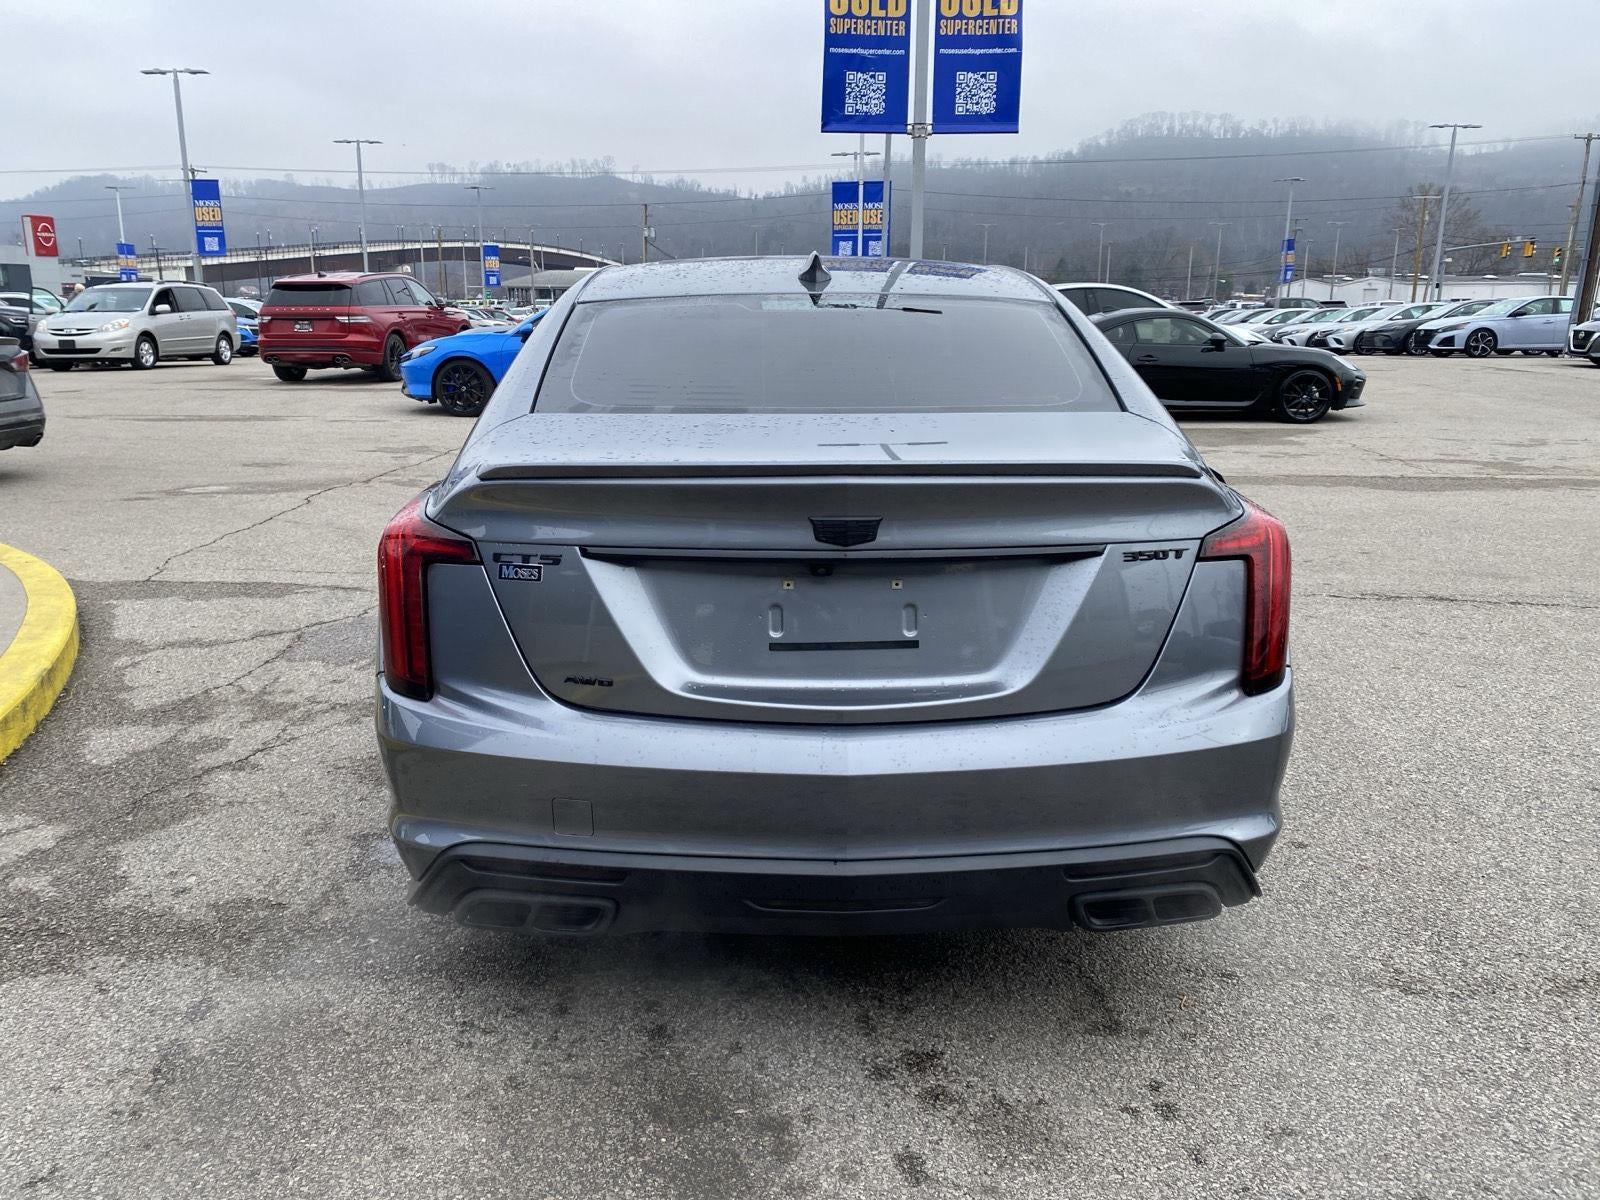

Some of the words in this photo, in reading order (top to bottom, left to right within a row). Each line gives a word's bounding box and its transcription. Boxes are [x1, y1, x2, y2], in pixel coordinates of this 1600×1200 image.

[829, 17, 906, 36] SUPERCENTER
[940, 18, 1018, 35] SUPERCENTER
[829, 47, 906, 56] mosesusedsupercenter.com
[939, 47, 1018, 55] mosesusedsupercenter.com
[195, 207, 221, 221] USED
[834, 210, 858, 224] USED
[863, 210, 882, 224] USE
[1122, 548, 1190, 563] 350T
[501, 565, 539, 580] MOSES
[563, 676, 614, 687] AWD
